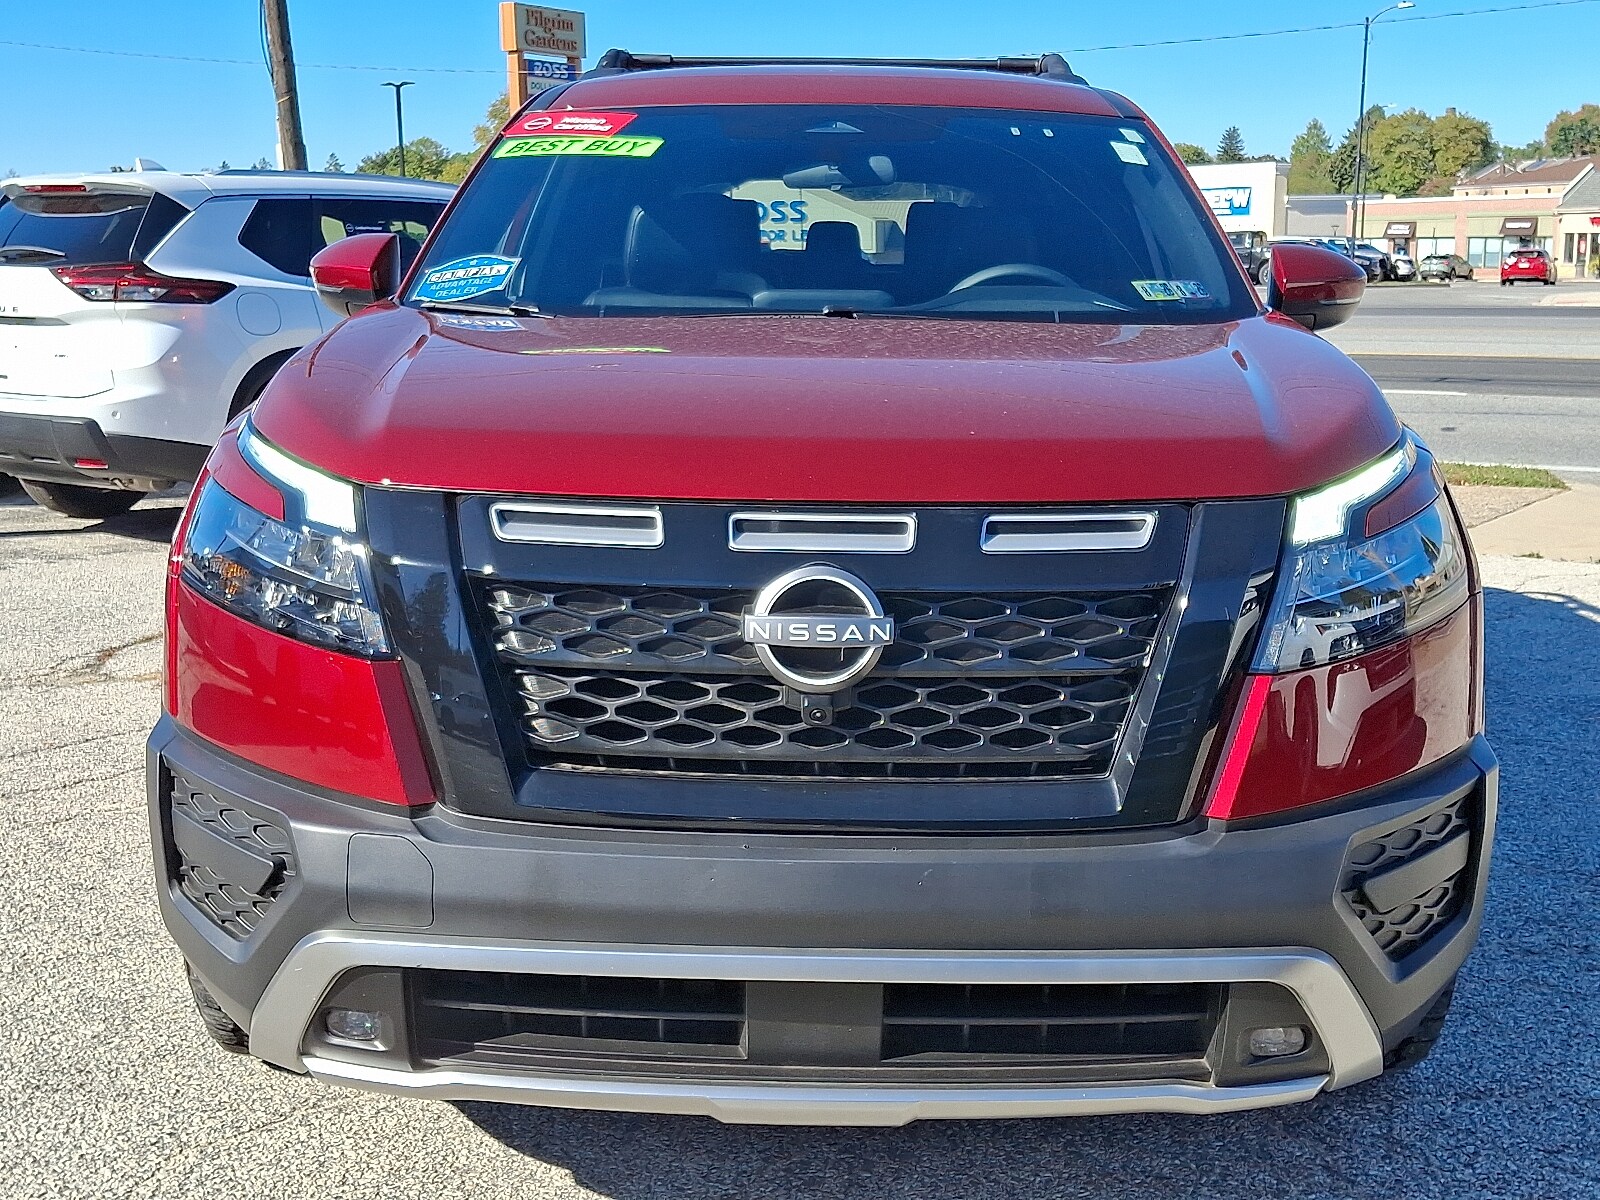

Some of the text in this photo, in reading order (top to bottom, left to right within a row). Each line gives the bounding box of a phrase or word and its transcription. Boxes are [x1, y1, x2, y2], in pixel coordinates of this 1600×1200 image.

[525, 8, 574, 34] Pilgrim
[524, 29, 578, 51] Gardens
[505, 139, 653, 155] BEST BUY
[430, 277, 495, 290] ADVANTAGE
[434, 286, 479, 297] DEALER
[749, 621, 891, 642] NISSAN
